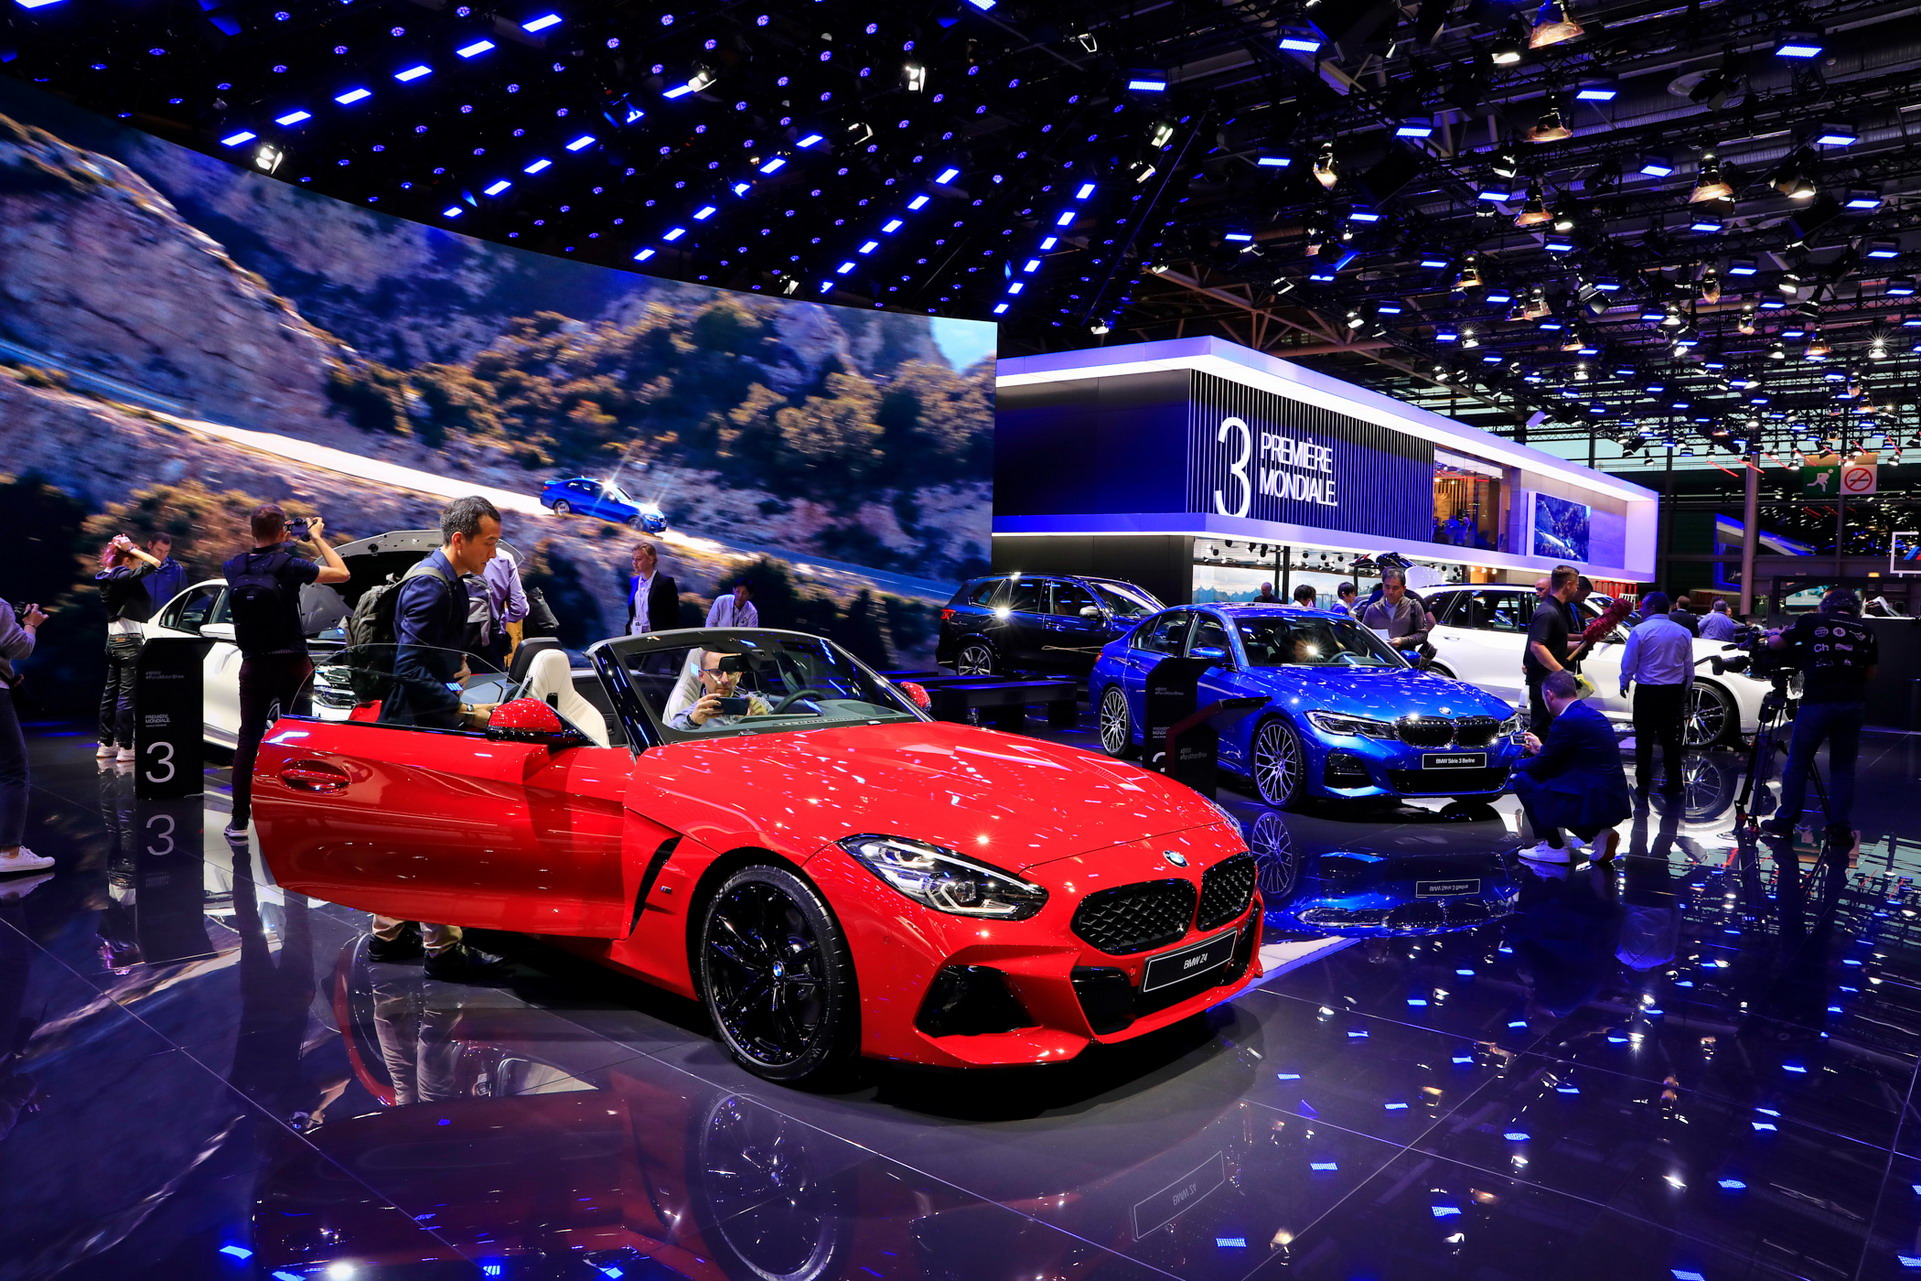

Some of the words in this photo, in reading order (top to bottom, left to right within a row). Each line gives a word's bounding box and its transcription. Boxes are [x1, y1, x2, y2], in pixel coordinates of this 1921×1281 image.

[1215, 416, 1251, 518] 3
[1260, 431, 1333, 474] PREMIÈRE
[145, 741, 176, 783] 3
[1183, 955, 1201, 970] BMW
[1199, 952, 1208, 964] Z4
